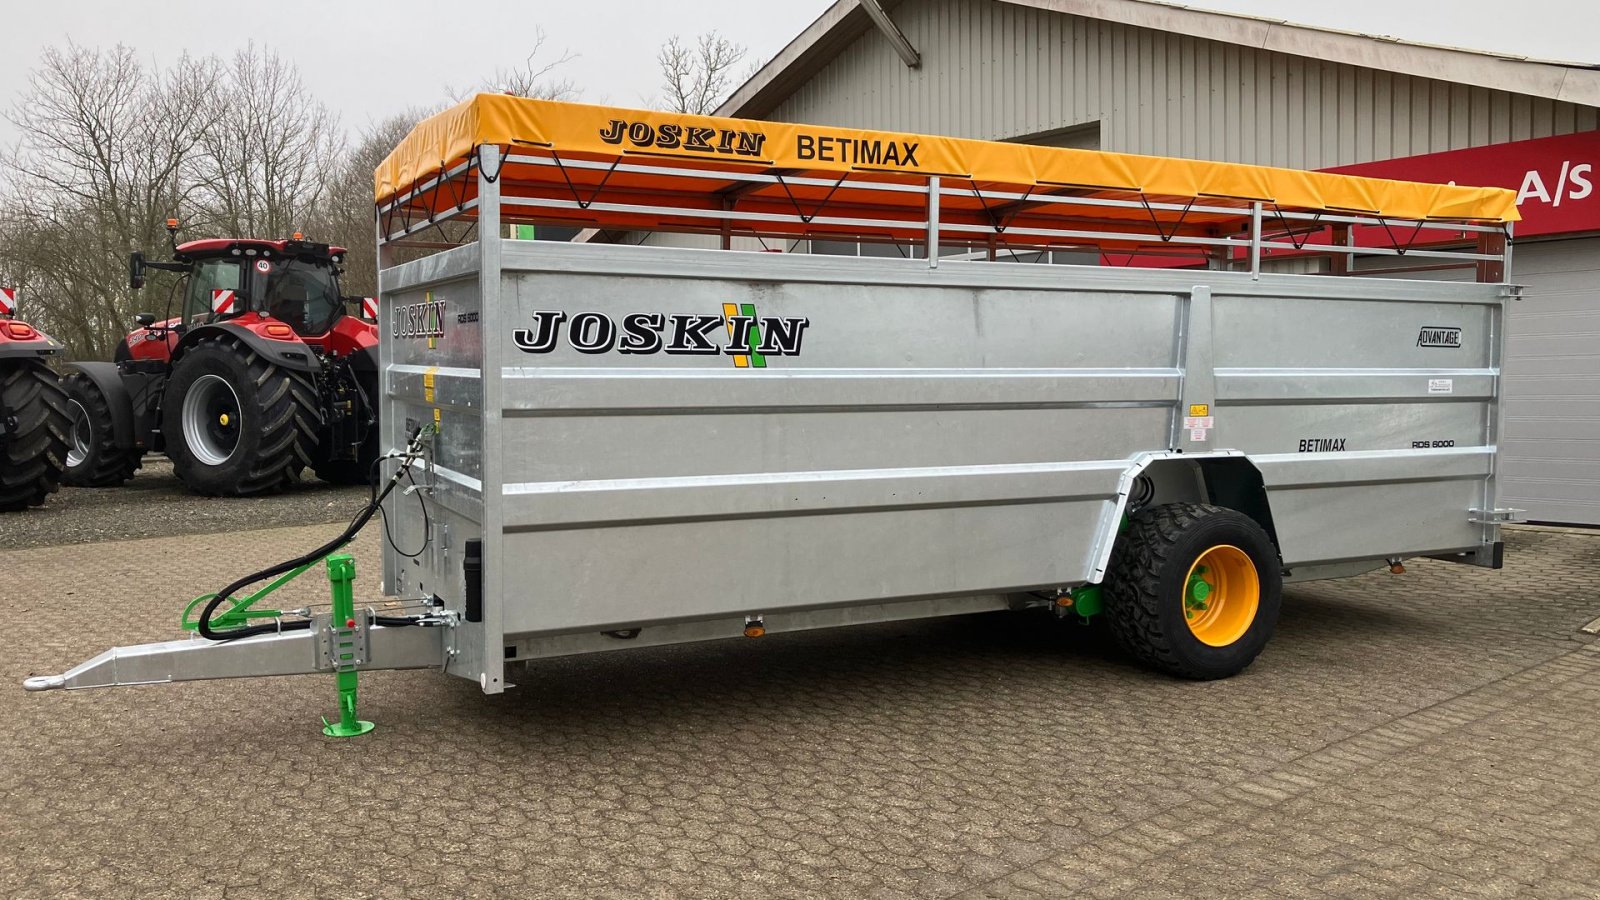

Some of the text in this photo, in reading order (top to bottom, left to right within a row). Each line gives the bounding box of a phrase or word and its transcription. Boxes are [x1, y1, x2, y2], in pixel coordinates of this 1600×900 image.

[599, 119, 920, 167] JOSKIN BETIMAX
[1515, 161, 1593, 207] A/S
[392, 300, 446, 339] JOSKIN
[513, 310, 810, 356] JOSKIN
[1416, 329, 1460, 347] ADVANTAGE
[1299, 438, 1346, 453] BETIMAX
[1412, 439, 1455, 448] RDS 6000
